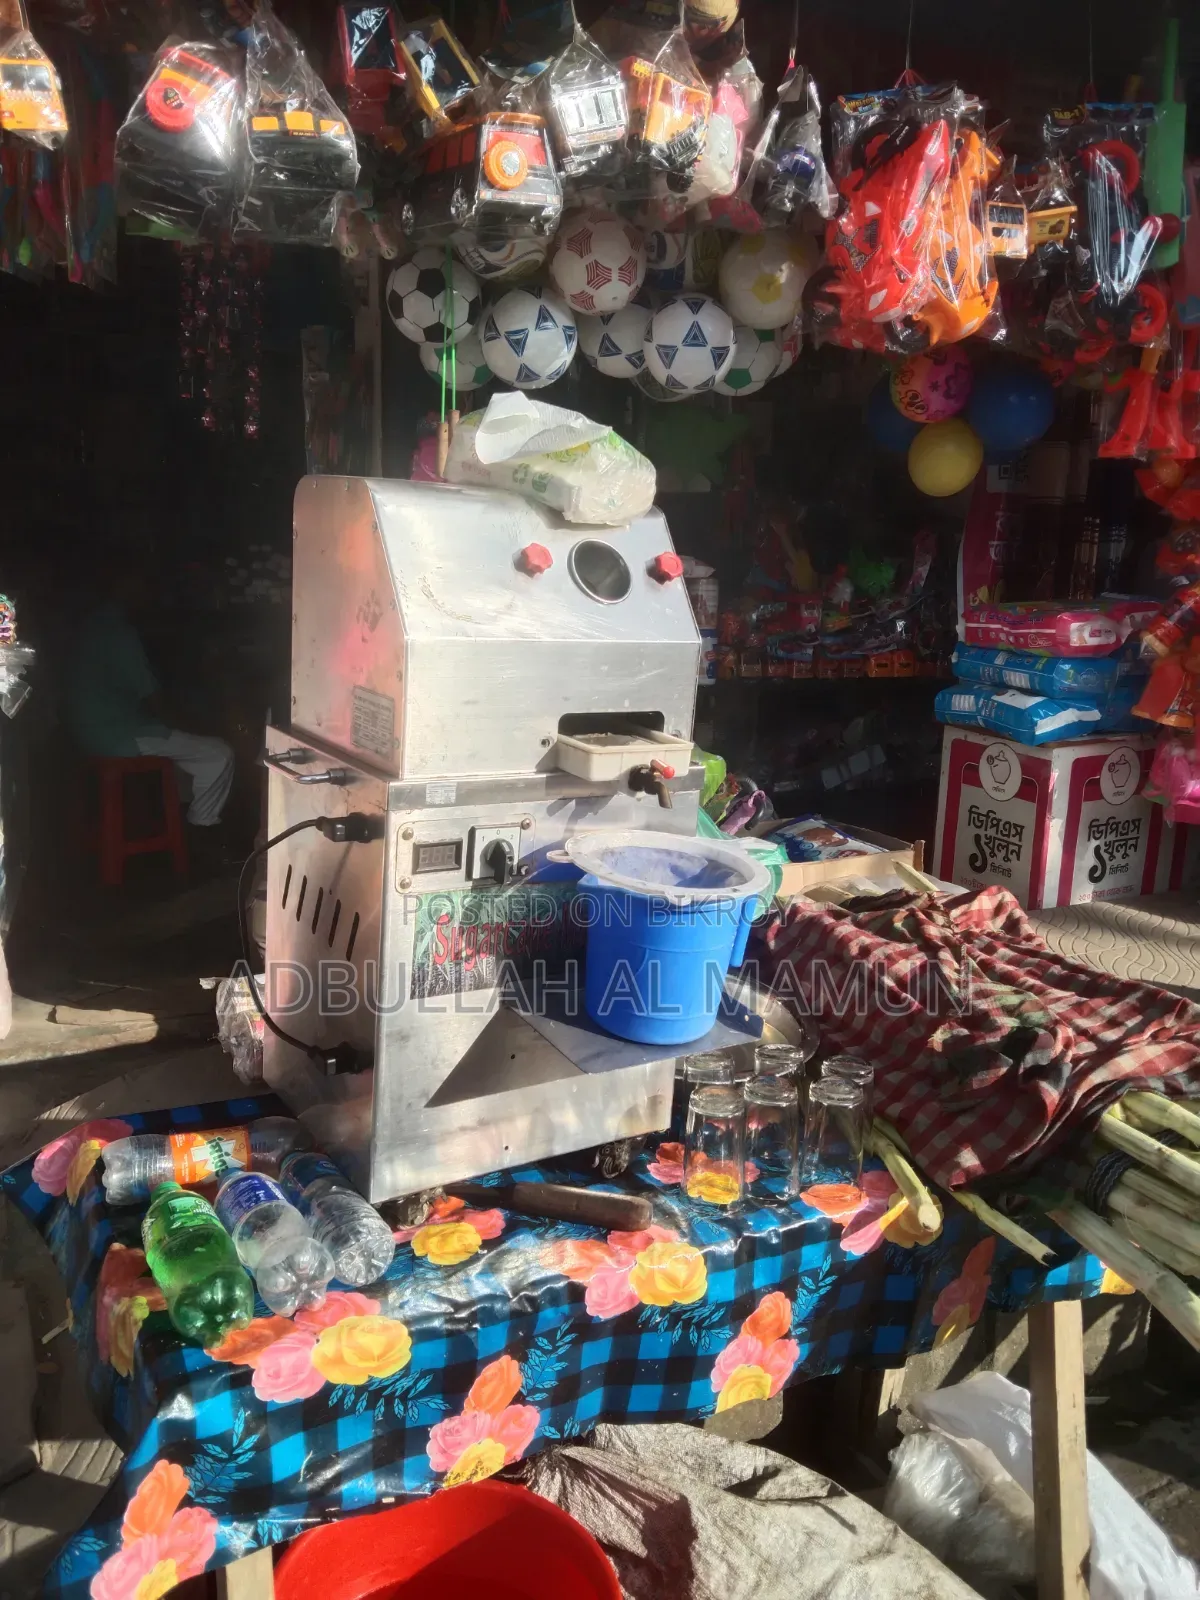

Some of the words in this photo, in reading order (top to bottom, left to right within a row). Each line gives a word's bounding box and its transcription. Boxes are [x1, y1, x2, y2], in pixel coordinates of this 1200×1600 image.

[967, 804, 1025, 843] ডিপিএস
[1087, 816, 1143, 842] ডিপিএস
[968, 833, 988, 874] ১
[990, 863, 1012, 878] মিনিটে
[984, 833, 1022, 864] খুলুন
[1088, 844, 1107, 884] ১
[1108, 863, 1129, 876] মিনিটে
[1103, 836, 1140, 862] খুলুন
